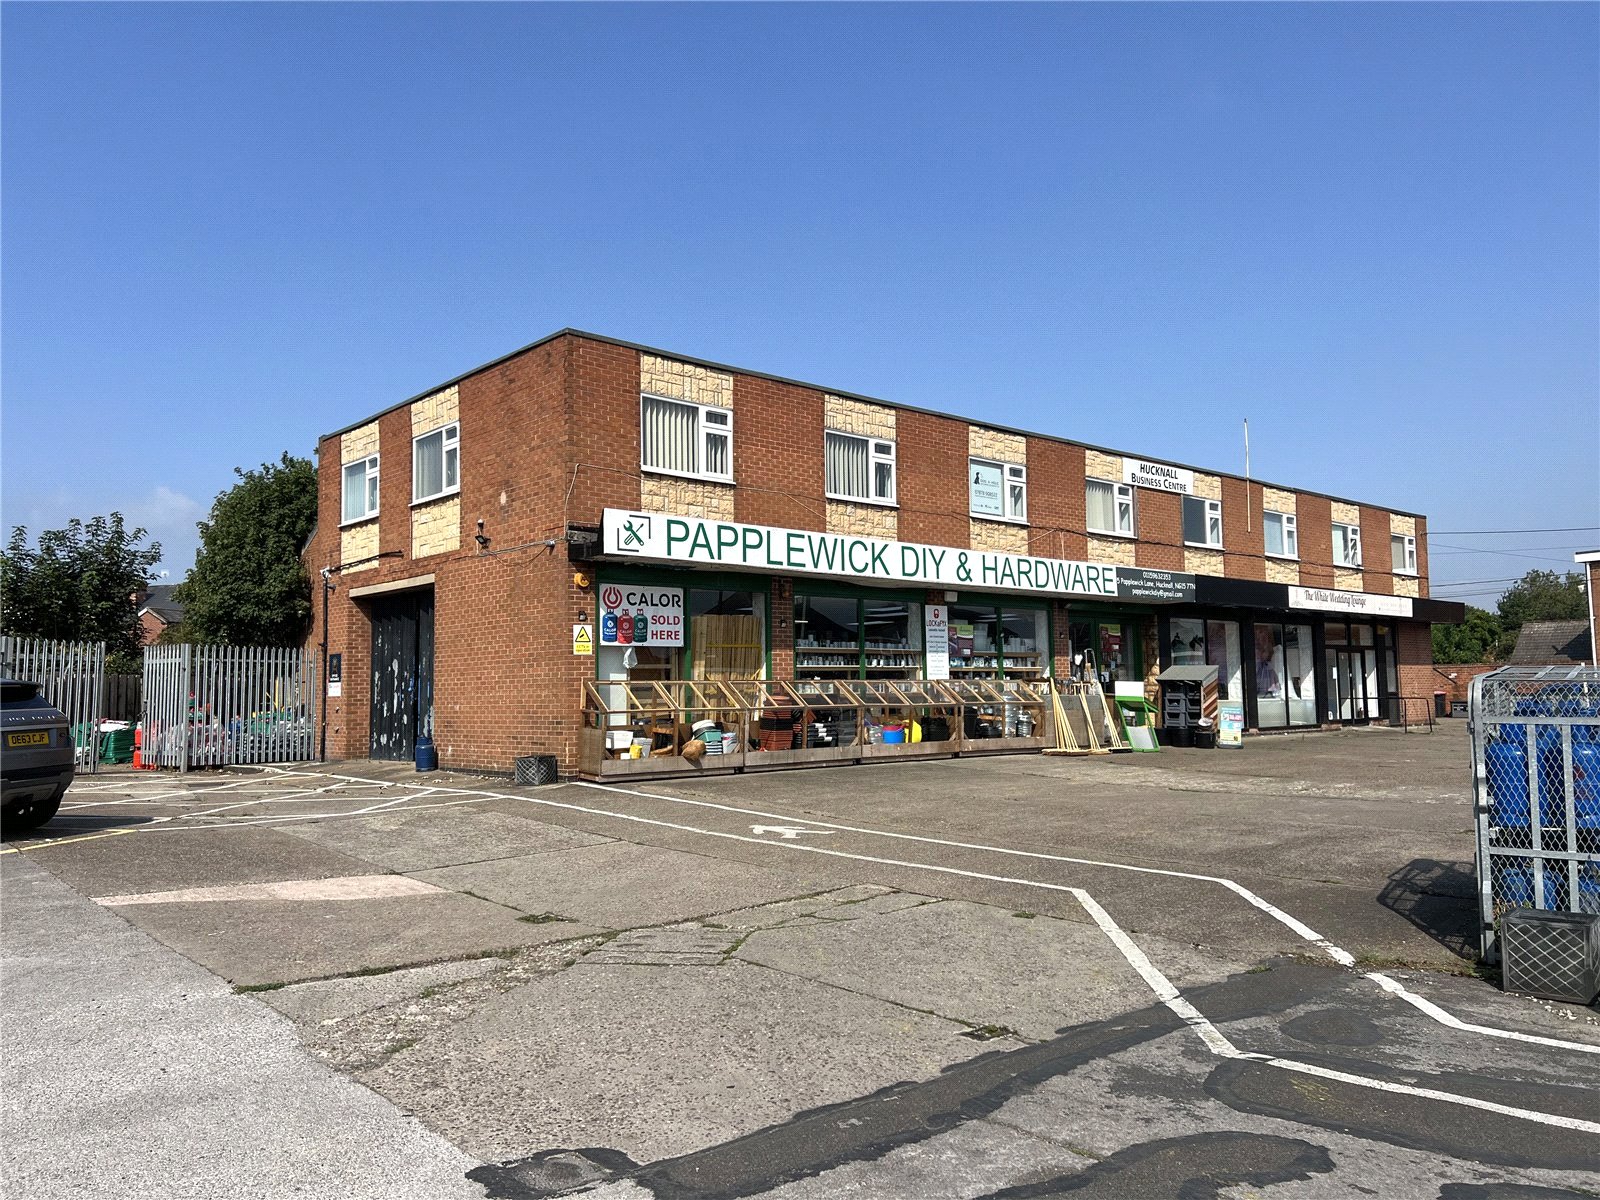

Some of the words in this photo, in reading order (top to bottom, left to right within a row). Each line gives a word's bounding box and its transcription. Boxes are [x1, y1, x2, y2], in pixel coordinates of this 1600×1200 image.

[1140, 463, 1179, 480] HUCKNALL
[666, 519, 890, 575] PAPPLEWICK
[901, 545, 946, 579] DIY
[956, 551, 973, 583] &
[982, 554, 1116, 594] HARDWARE
[1120, 577, 1143, 587] Papplewick
[626, 591, 682, 608] CALOR
[1304, 589, 1313, 601] The
[1314, 590, 1329, 602] White
[1329, 592, 1350, 607] Wedding
[651, 615, 680, 626] SOLD
[651, 630, 680, 640] HERE
